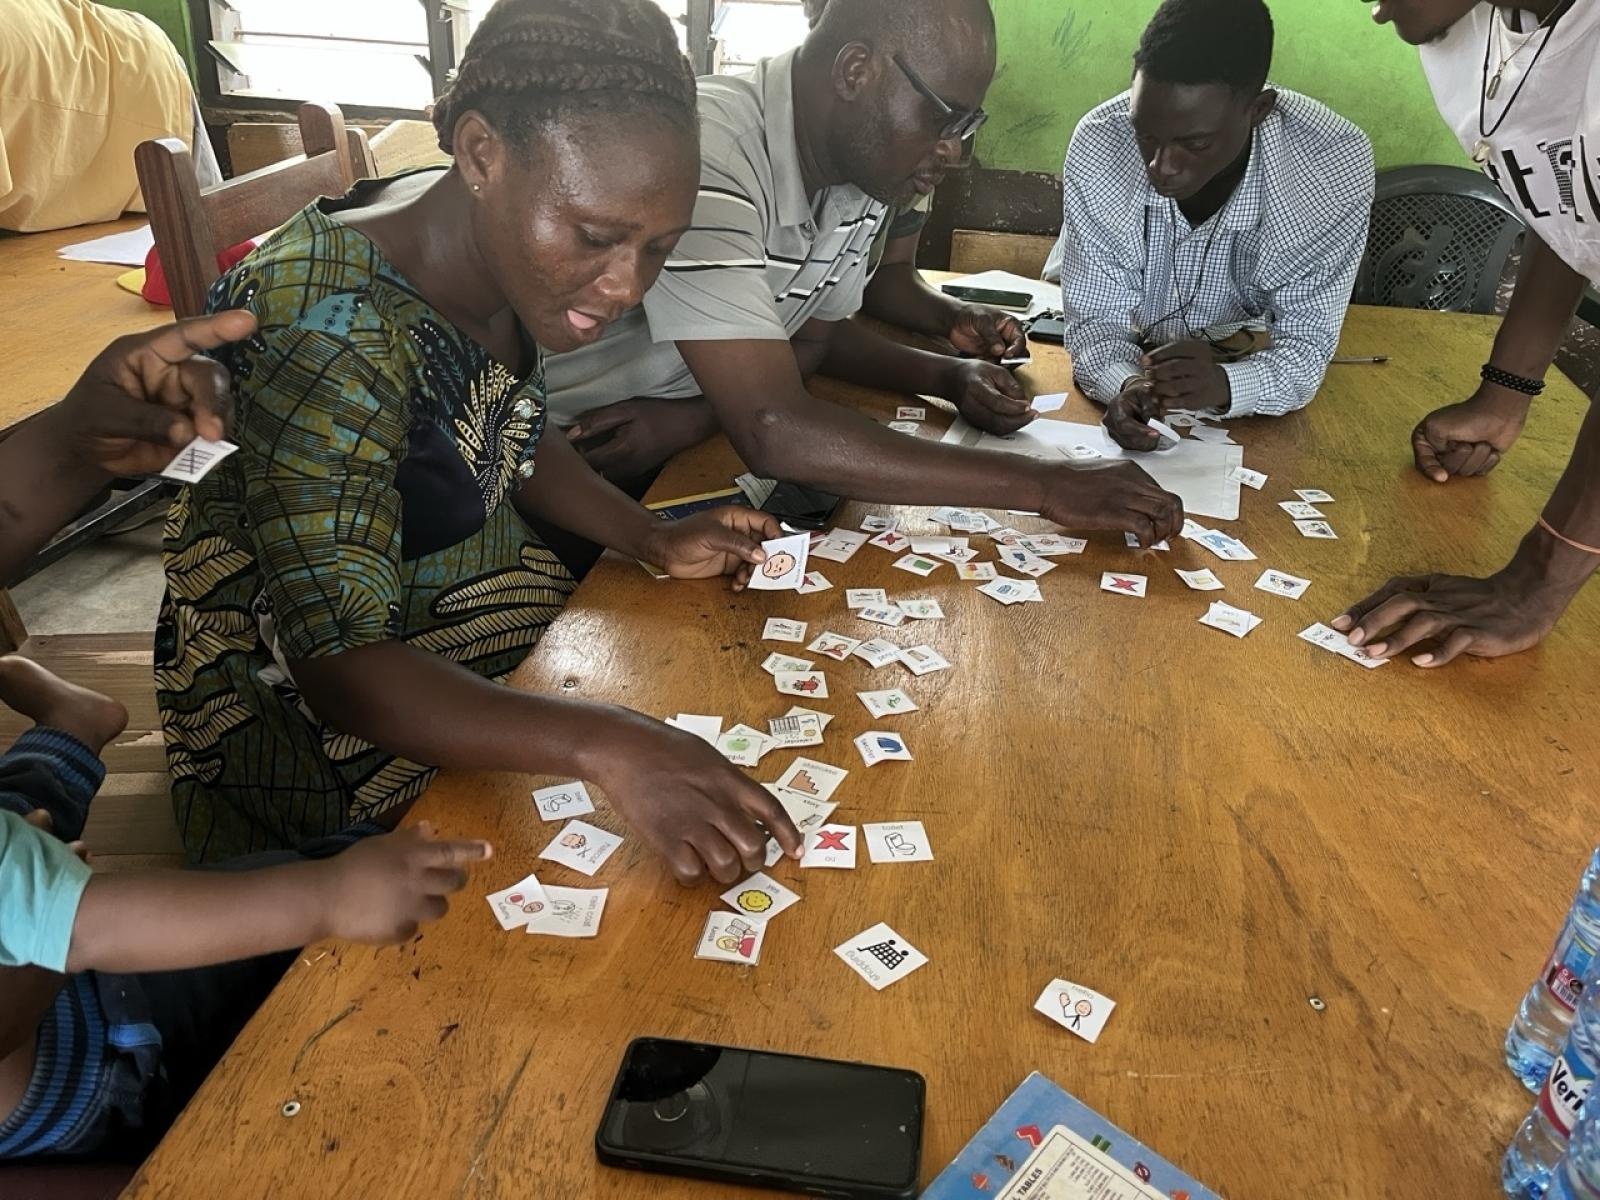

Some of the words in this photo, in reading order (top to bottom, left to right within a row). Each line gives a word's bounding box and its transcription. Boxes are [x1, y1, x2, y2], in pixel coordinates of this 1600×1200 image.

[588, 841, 611, 864] haircut
[825, 855, 836, 863] no
[767, 883, 781, 895] yes
[845, 948, 881, 982] shopping
[1016, 1167, 1043, 1196] TABLES
